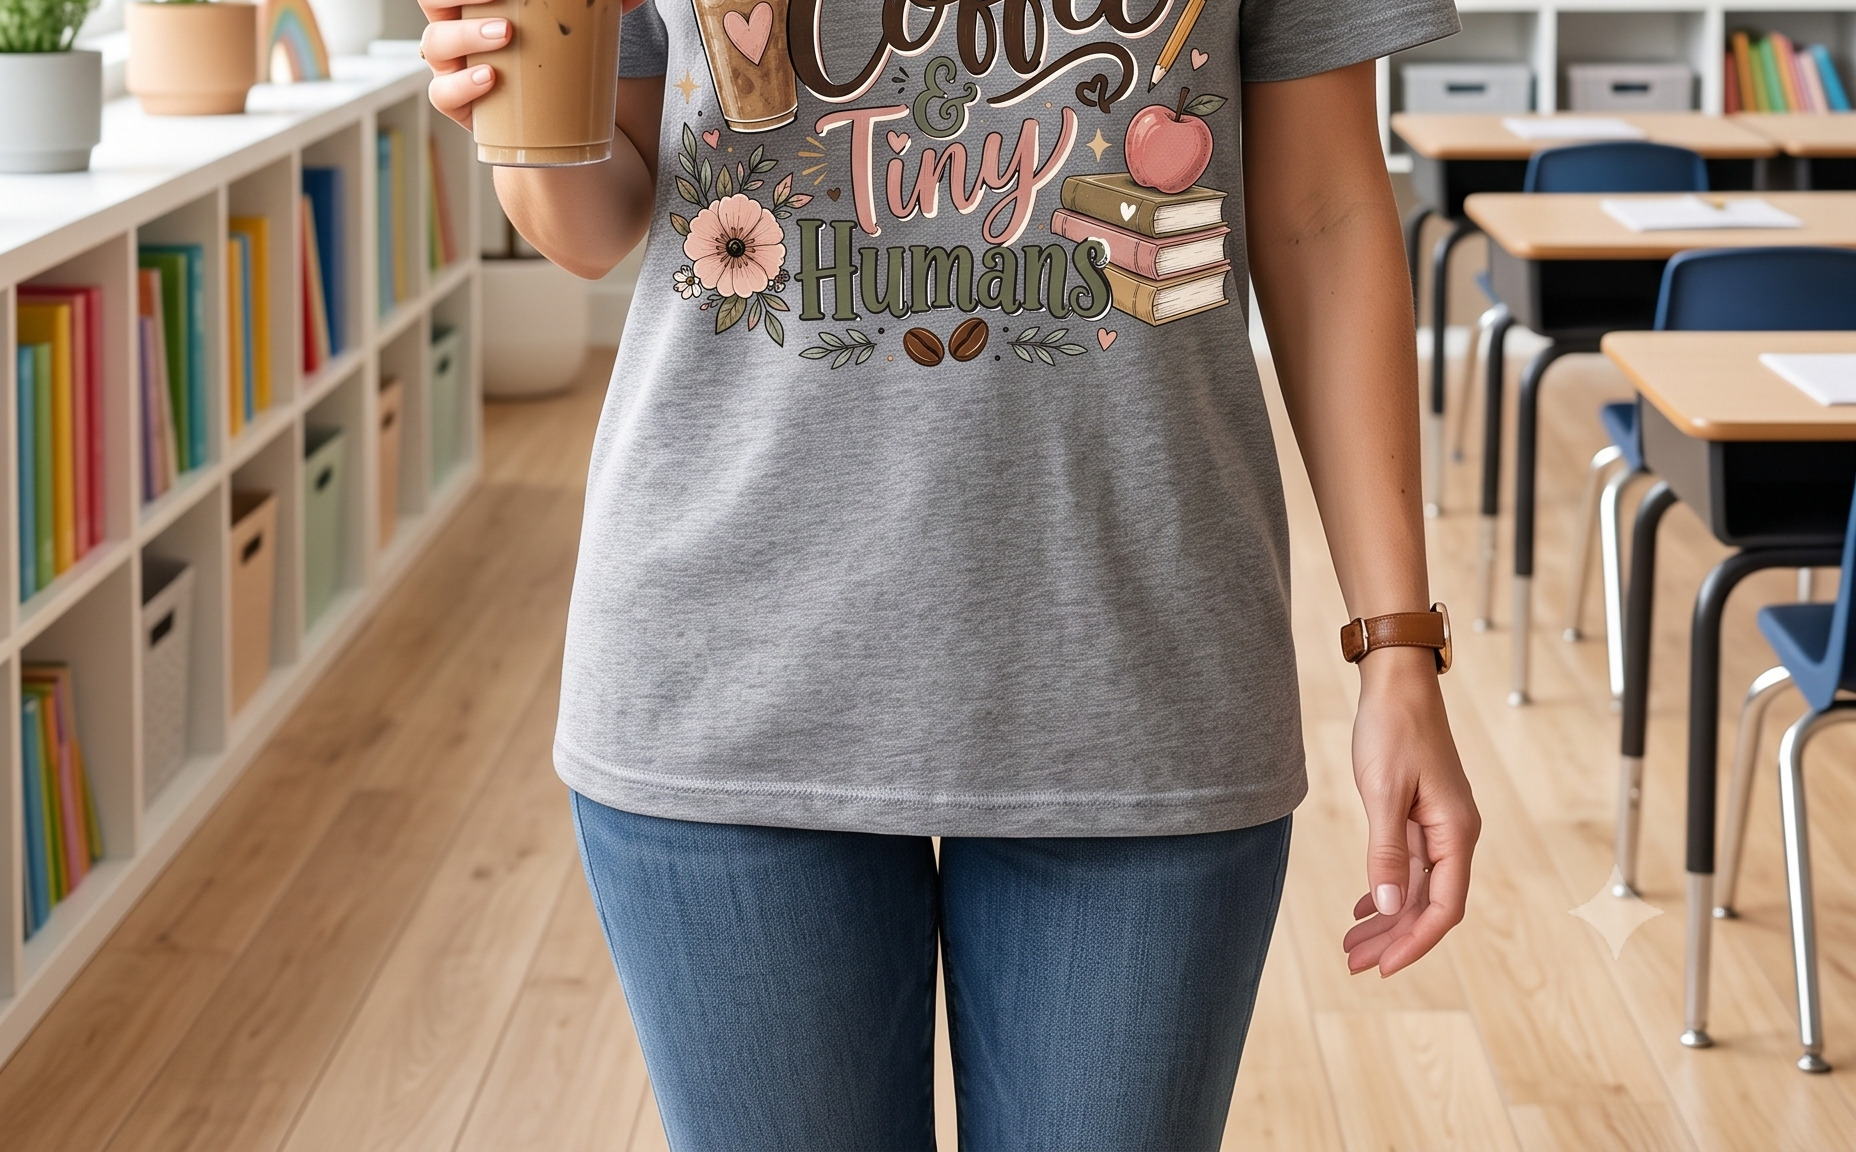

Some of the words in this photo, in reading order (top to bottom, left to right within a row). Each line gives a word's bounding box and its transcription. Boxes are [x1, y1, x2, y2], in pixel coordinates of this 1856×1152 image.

[913, 55, 982, 140] &
[814, 104, 1079, 247] Tiny
[795, 219, 1112, 322] Humans
